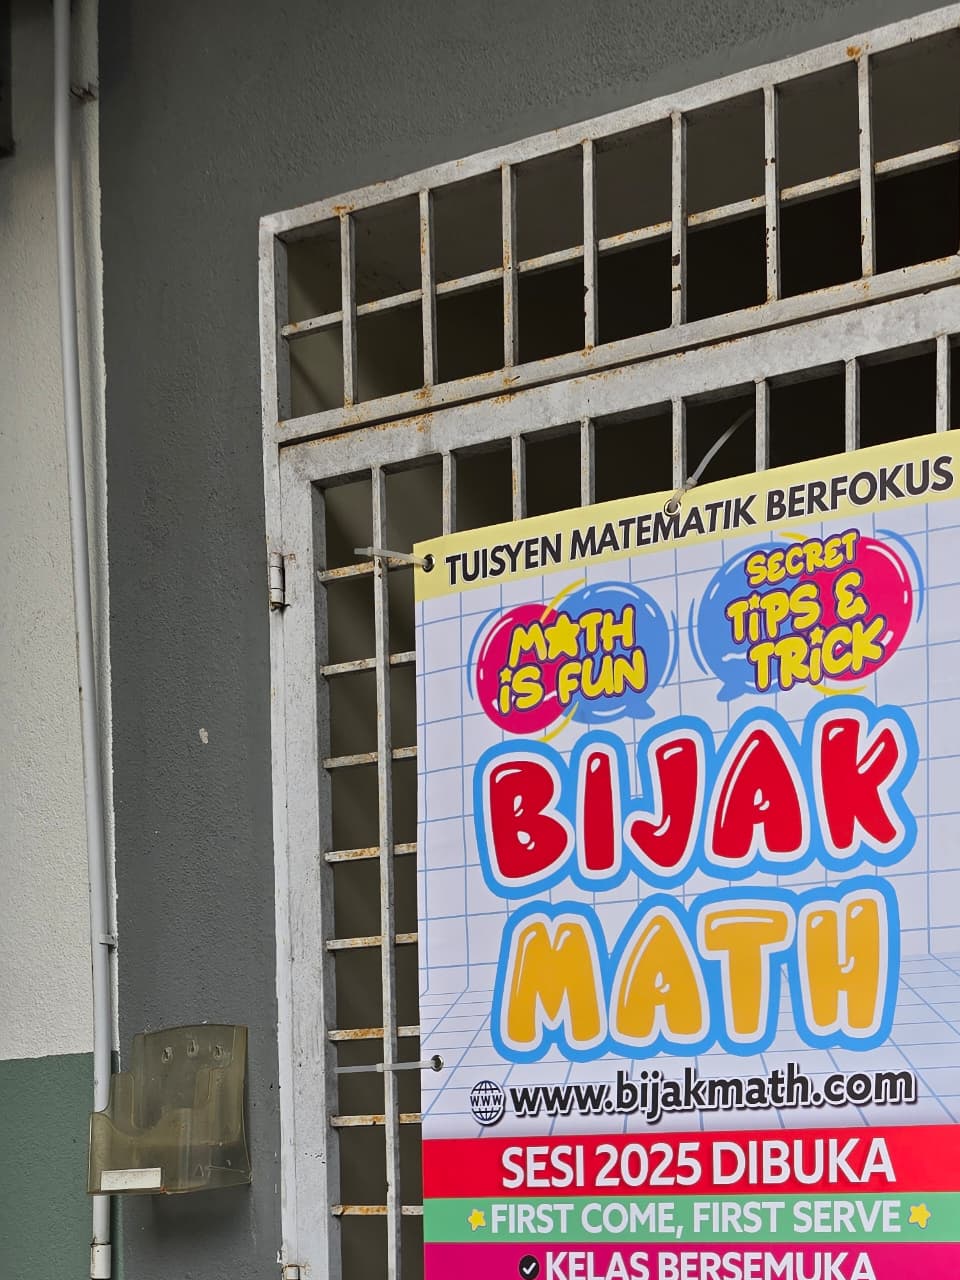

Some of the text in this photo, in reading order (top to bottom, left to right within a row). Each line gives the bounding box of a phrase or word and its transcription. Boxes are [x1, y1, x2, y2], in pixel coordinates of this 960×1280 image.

[446, 455, 954, 585] TUISYEN MATEMATIK BERFOKUS
[745, 529, 859, 588] SECRET
[556, 649, 647, 704] FUN
[485, 715, 904, 882] BIJAK
[505, 895, 889, 1046] MATH
[509, 1063, 916, 1126] www.bijakmath.com
[502, 1138, 896, 1188] SESI 2025 DIBUKA
[491, 1200, 900, 1239] FIRST COME, FIRST SERVE
